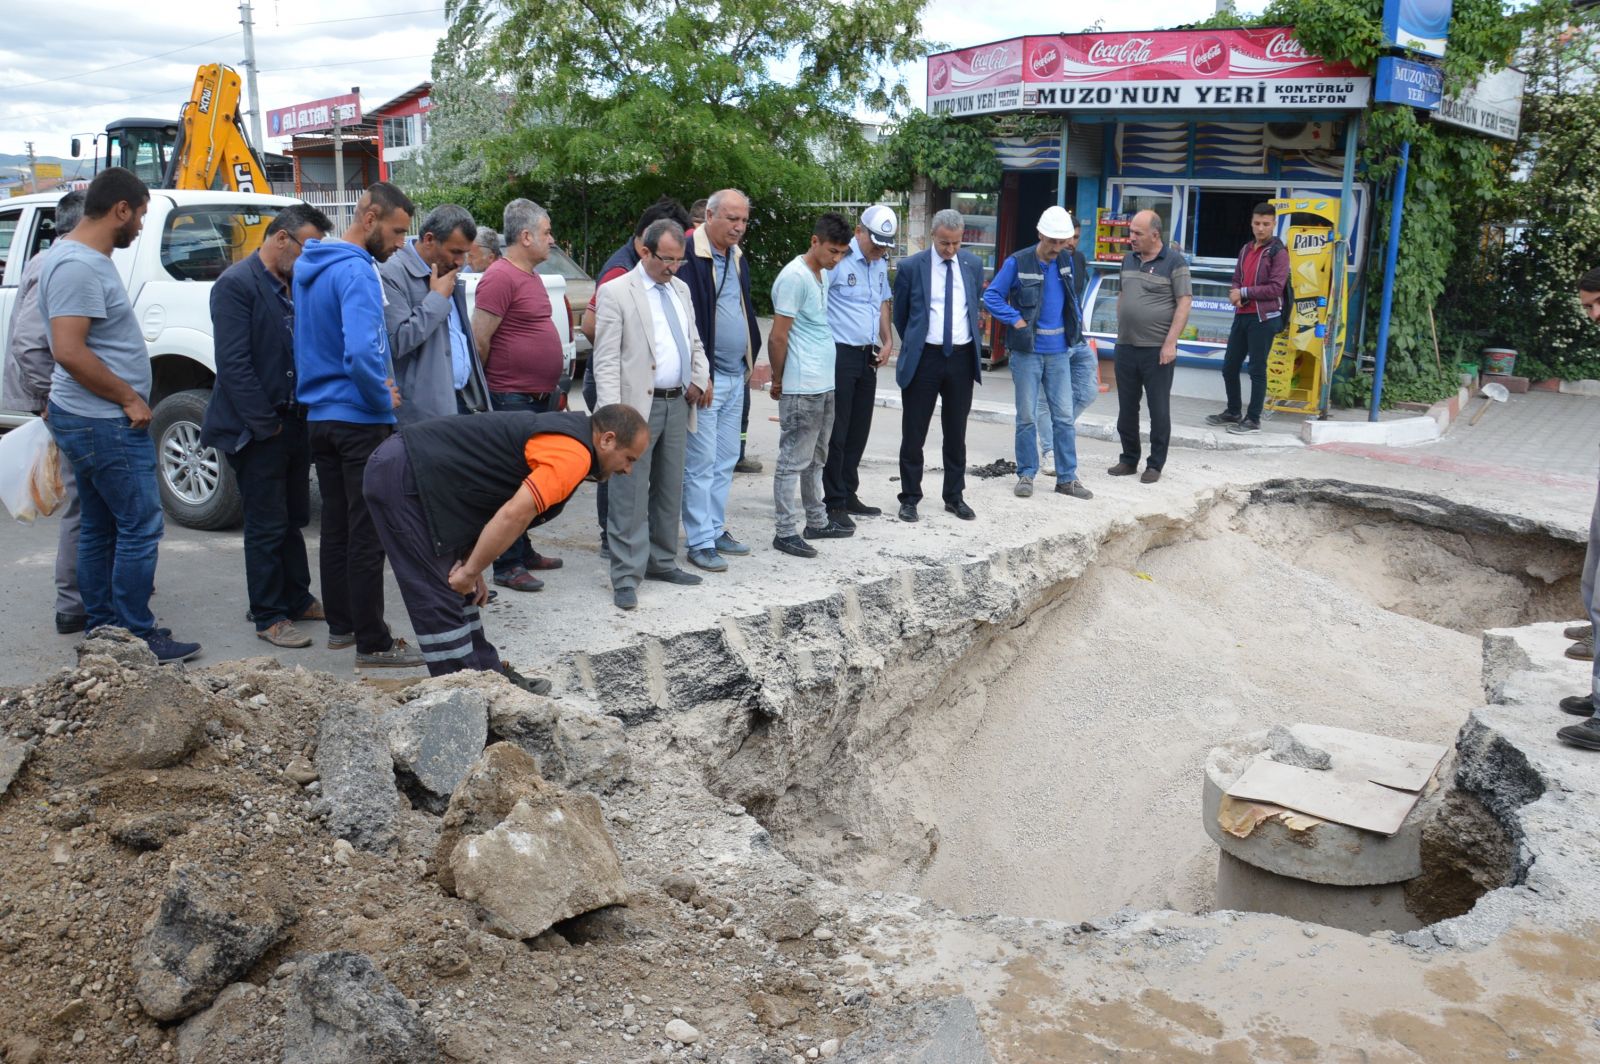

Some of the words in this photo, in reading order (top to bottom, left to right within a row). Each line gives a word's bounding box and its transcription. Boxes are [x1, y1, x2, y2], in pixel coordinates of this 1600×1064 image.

[1037, 87, 1181, 104] MUZO'NUN
[1195, 82, 1267, 103] YERİ
[1275, 82, 1355, 93] KONTÜRLÜ
[977, 88, 997, 109] YERİ
[1280, 95, 1347, 103] TELEFON
